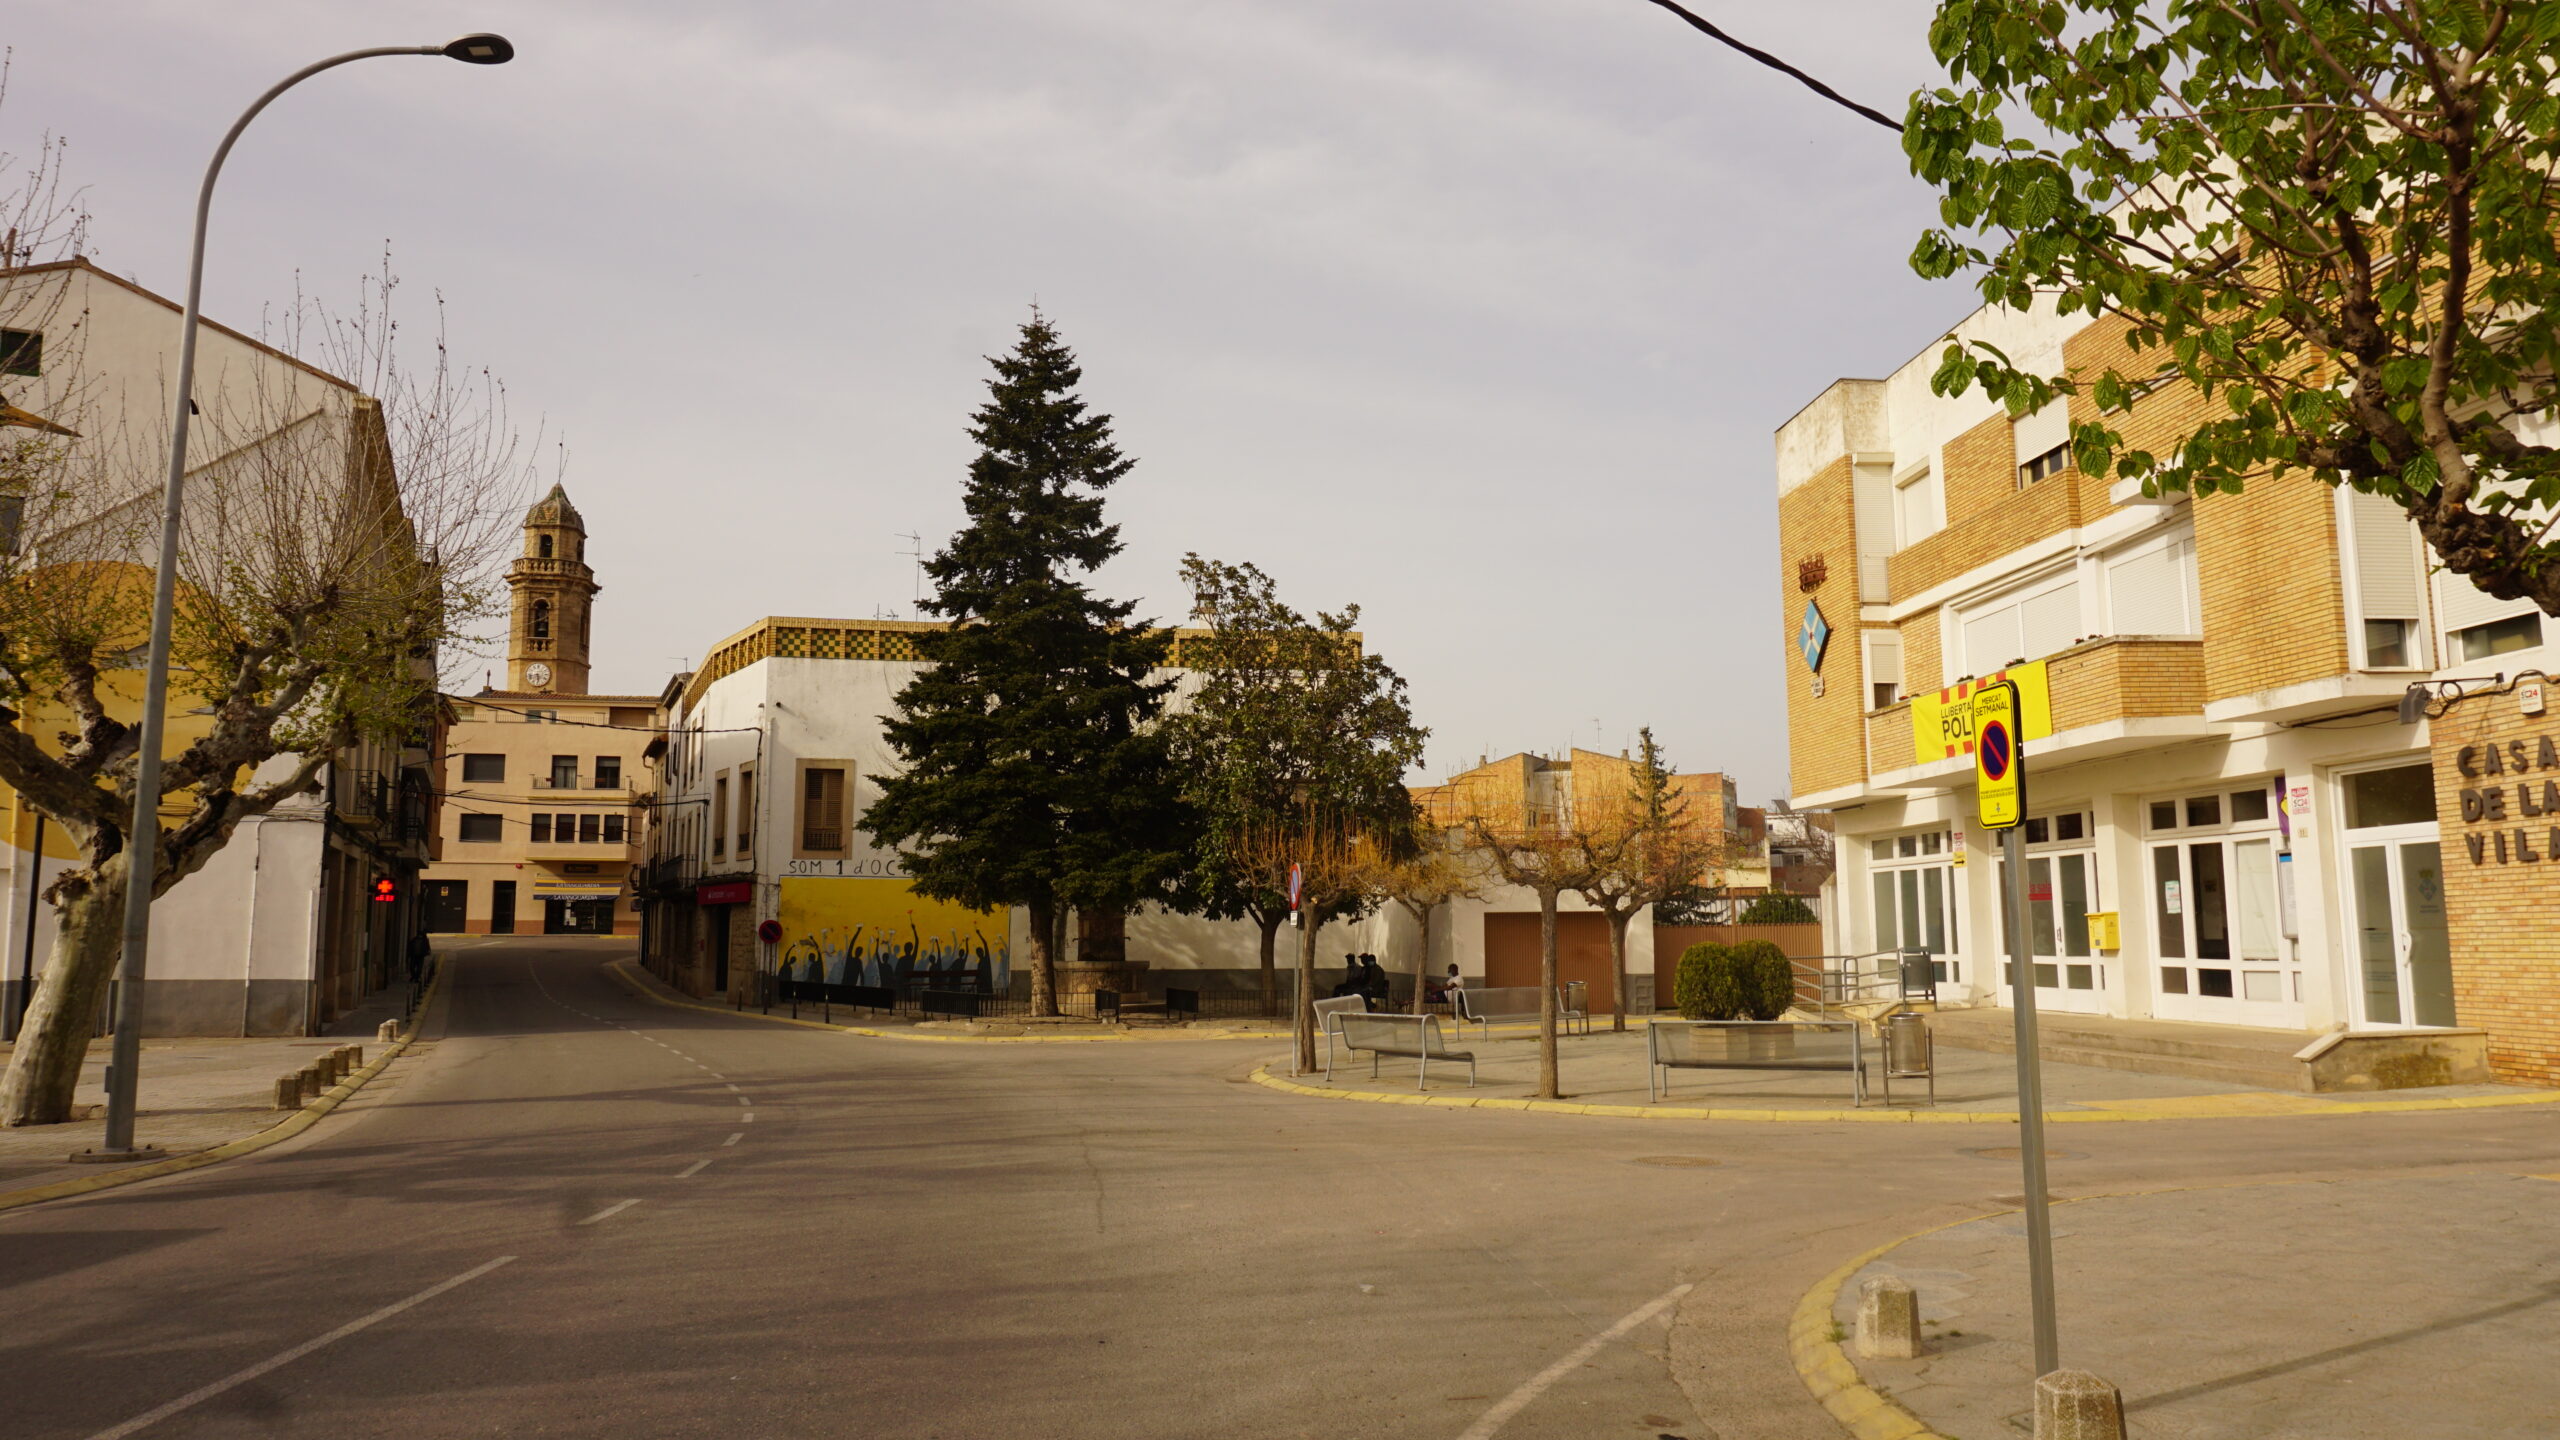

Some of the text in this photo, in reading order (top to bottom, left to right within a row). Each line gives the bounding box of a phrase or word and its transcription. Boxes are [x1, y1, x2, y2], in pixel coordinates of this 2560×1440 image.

[1981, 693, 2001, 705] MERCAT
[1975, 700, 2009, 717] SETMANAL
[2457, 735, 2560, 778] CASA
[2459, 780, 2560, 823] DE LA
[788, 860, 822, 874] SOM
[836, 859, 843, 875] 1
